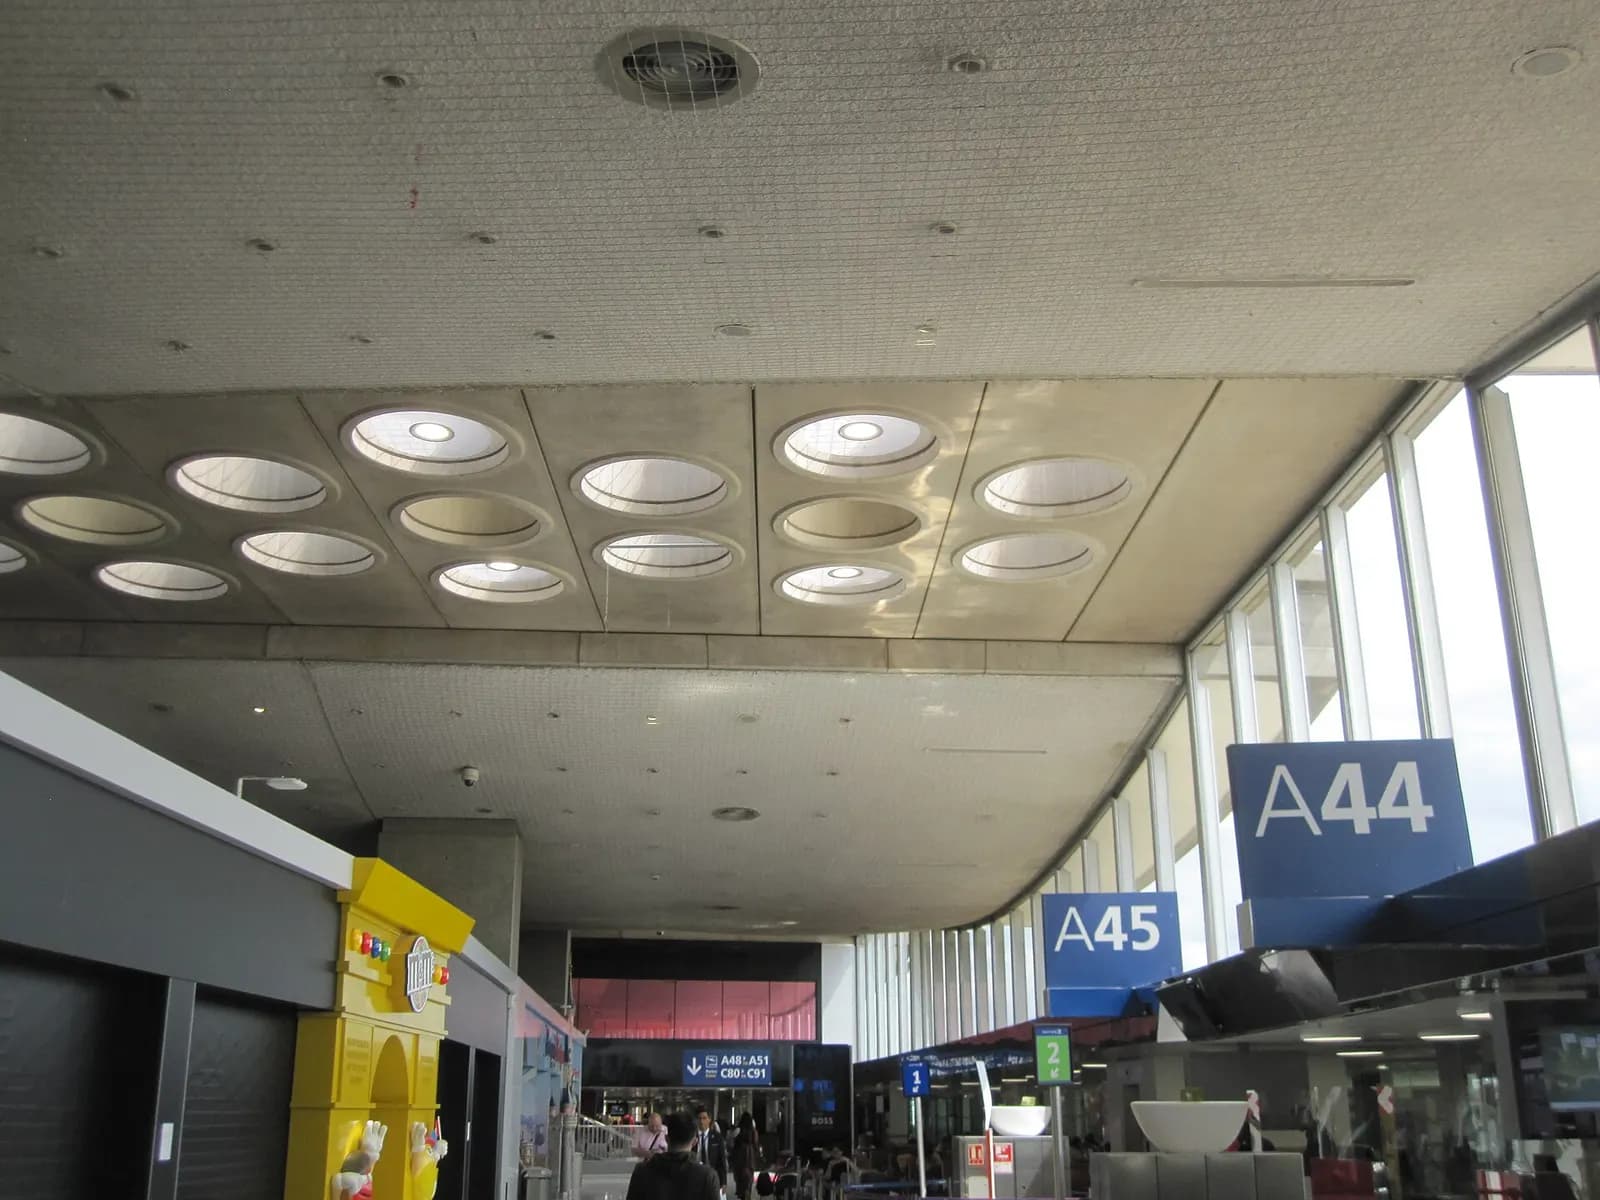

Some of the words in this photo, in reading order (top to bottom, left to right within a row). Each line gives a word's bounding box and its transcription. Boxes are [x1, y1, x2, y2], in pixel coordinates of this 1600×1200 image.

[1255, 761, 1434, 837] A44
[1054, 905, 1160, 952] A45
[720, 1055, 742, 1066] A48
[748, 1055, 769, 1066] A51
[1047, 1042, 1060, 1065] 2
[720, 1068, 741, 1079] C80
[747, 1068, 766, 1079] C91
[912, 1070, 921, 1085] 1
